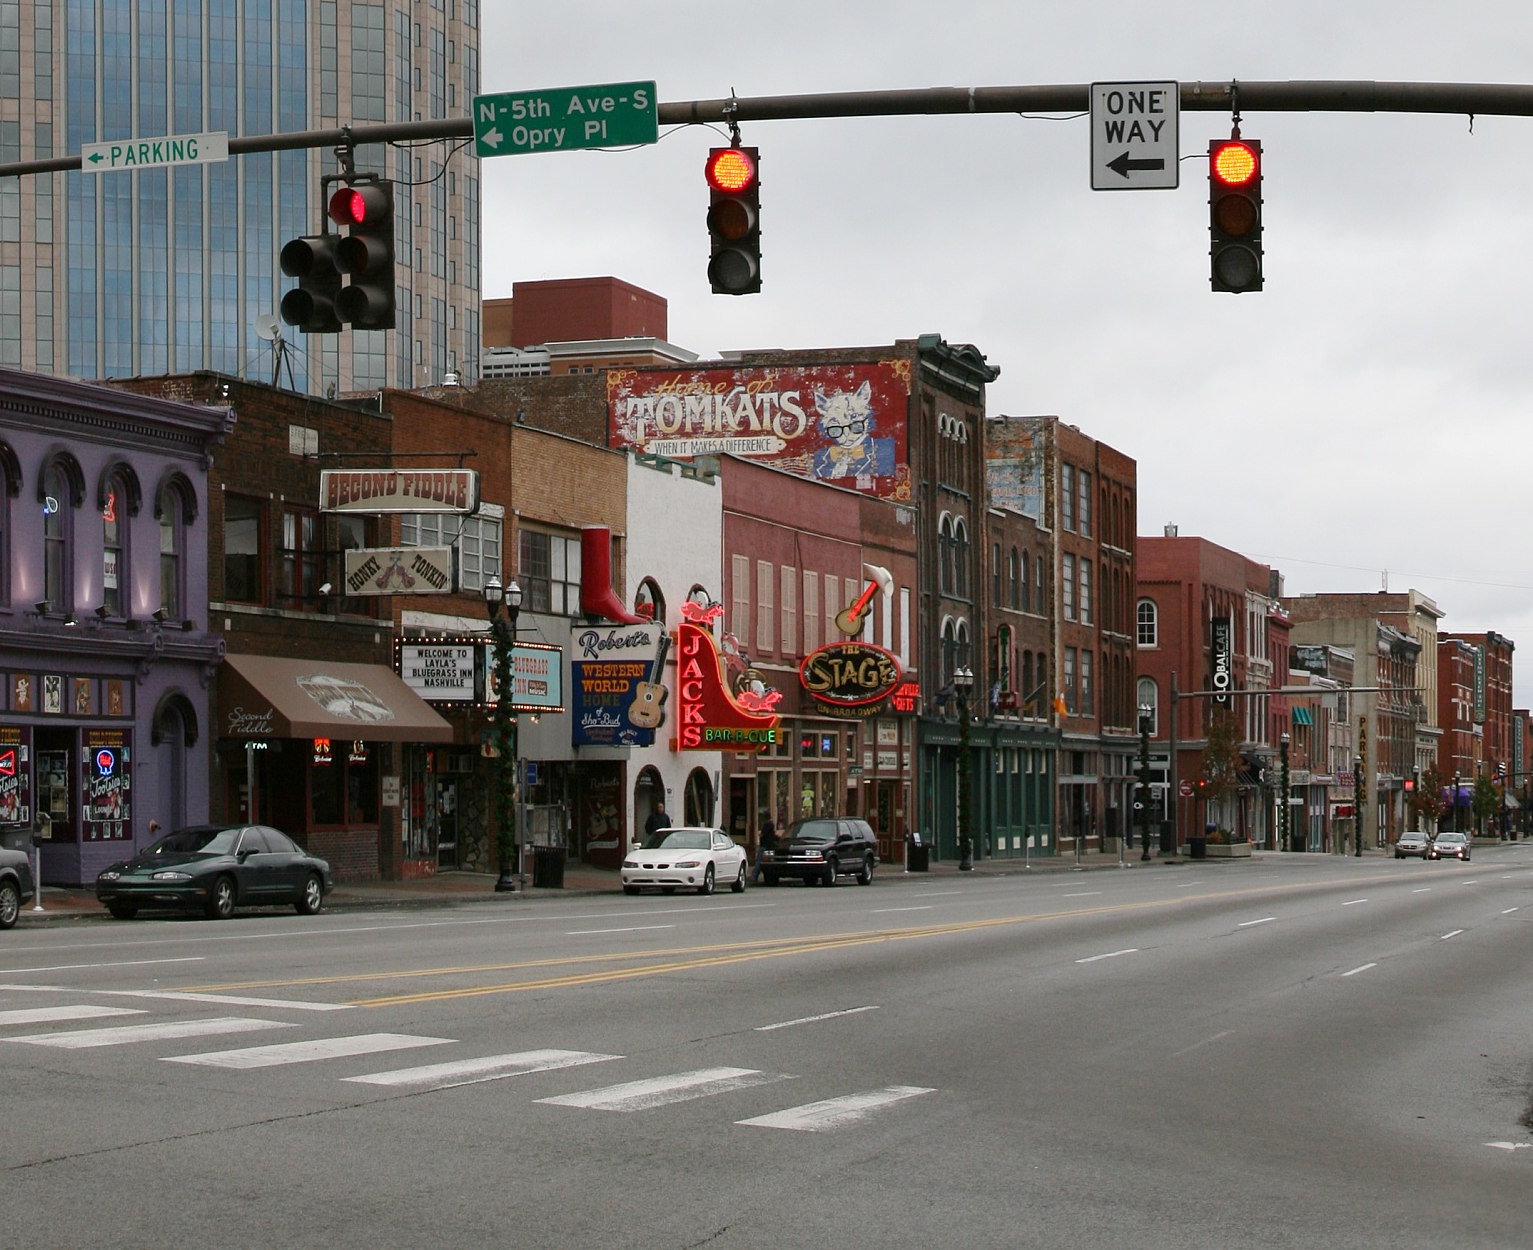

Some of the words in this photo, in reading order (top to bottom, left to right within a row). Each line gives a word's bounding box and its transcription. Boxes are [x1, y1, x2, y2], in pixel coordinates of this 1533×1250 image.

[480, 98, 551, 122] N-5th
[567, 89, 649, 115] Ave-S
[1107, 90, 1164, 115] ONE
[512, 125, 566, 149] Opry
[585, 119, 607, 140] Pl
[1105, 119, 1166, 144] WAY
[111, 138, 198, 167] PARKING
[626, 386, 807, 446] TOMKATS
[654, 440, 677, 454] WHEN
[679, 440, 688, 453] IT
[690, 440, 717, 453] MAKES
[718, 440, 725, 452] A
[726, 438, 771, 452] DIFFERENCE
[327, 472, 398, 510] SECOND
[402, 472, 468, 509] FIDDLE
[347, 556, 382, 592] HONKY
[417, 649, 454, 658] WELCOME
[457, 650, 467, 658] TO
[578, 630, 652, 660] Robert's
[841, 645, 860, 655] THE
[425, 659, 457, 668] LAYLA'S
[514, 655, 549, 675] BLUEGRASS
[581, 663, 646, 678] WESTERN
[412, 668, 457, 677] BLUEGRASS
[459, 669, 473, 677] INN
[807, 652, 896, 693] STAGE
[424, 678, 465, 687] NASHVILLE
[514, 677, 527, 695] INN
[581, 680, 630, 693] WORLD
[682, 635, 707, 747] JACKS
[583, 694, 620, 707] HOME
[228, 707, 274, 722] Second
[817, 703, 830, 715] ON
[834, 705, 882, 716] BROADWAY
[228, 721, 274, 734] Fiddle
[581, 713, 621, 726] Sho-Bud
[705, 729, 776, 743] BAR-B-QUE
[91, 775, 121, 798] Tootsies
